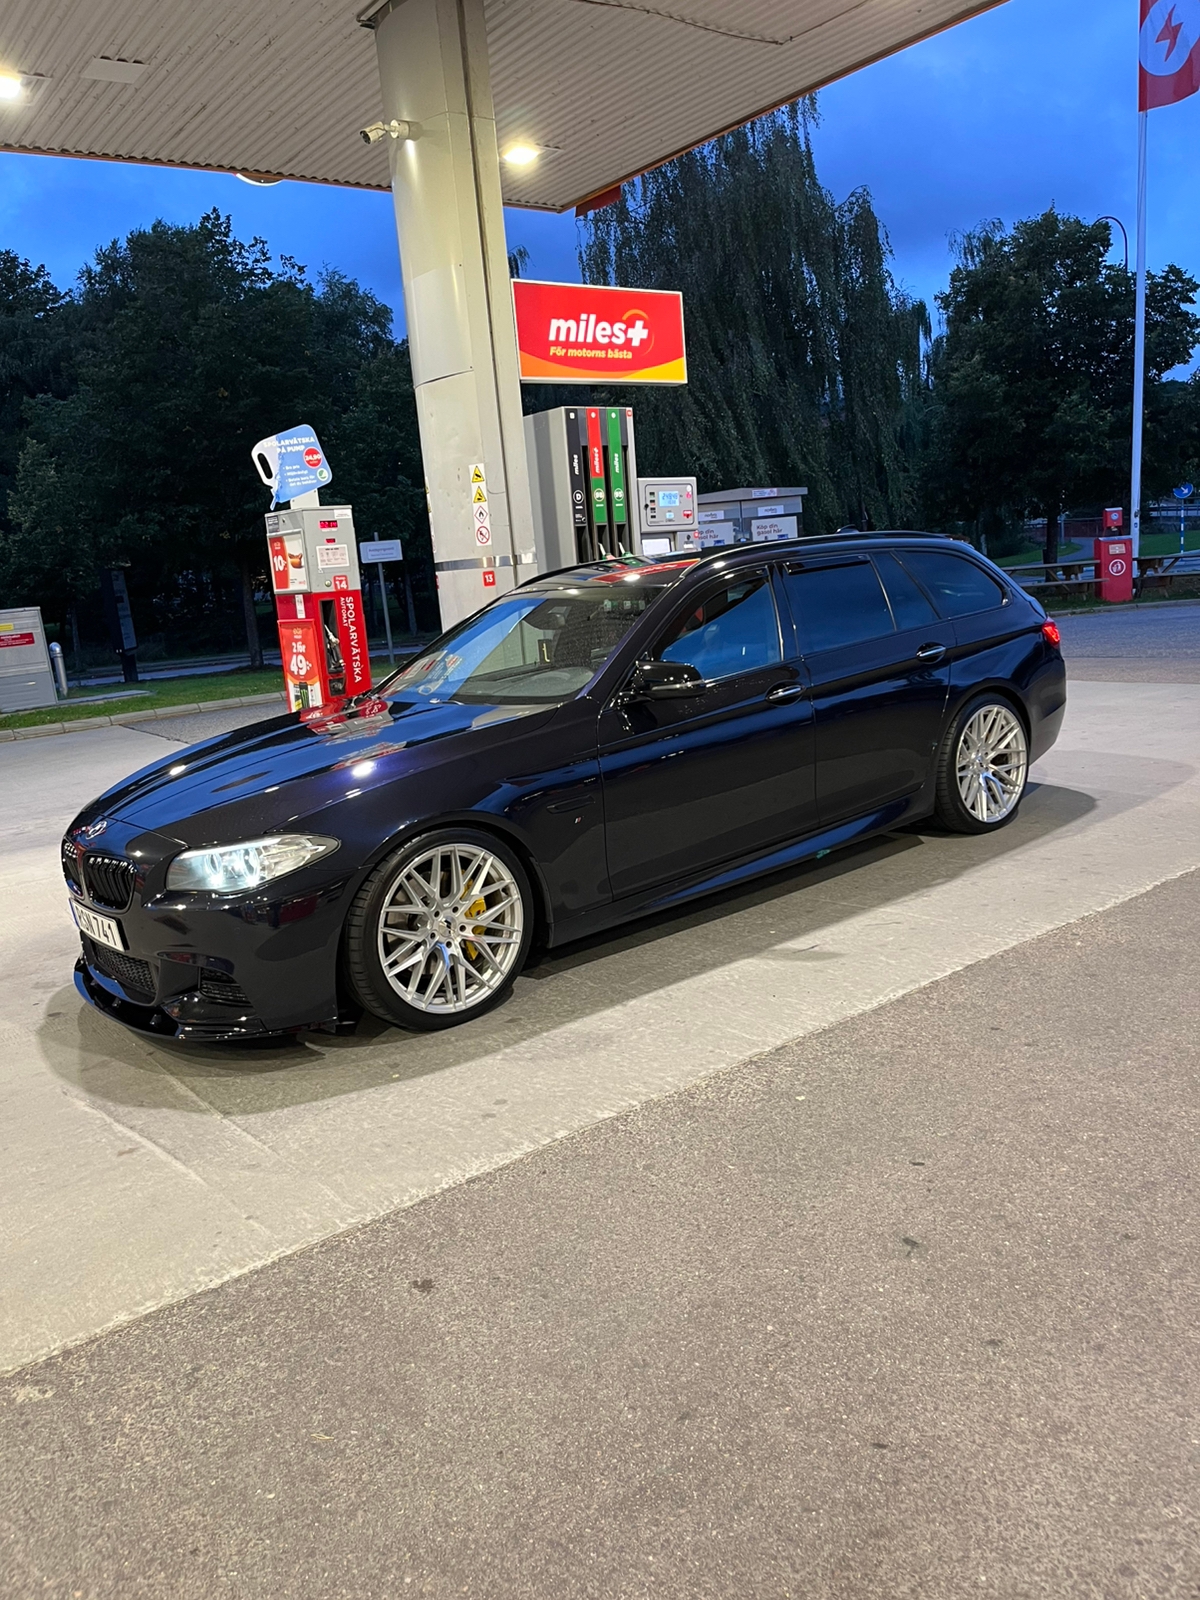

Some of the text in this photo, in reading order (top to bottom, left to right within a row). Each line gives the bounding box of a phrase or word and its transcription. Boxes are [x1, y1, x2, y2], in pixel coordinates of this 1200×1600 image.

[550, 346, 633, 359] För motorns bästa
[335, 580, 347, 589] 14
[485, 574, 493, 582] 13
[340, 597, 348, 627] AUTOMAT
[346, 596, 362, 683] SPOLARVÄTSKA
[92, 916, 117, 946] 741
